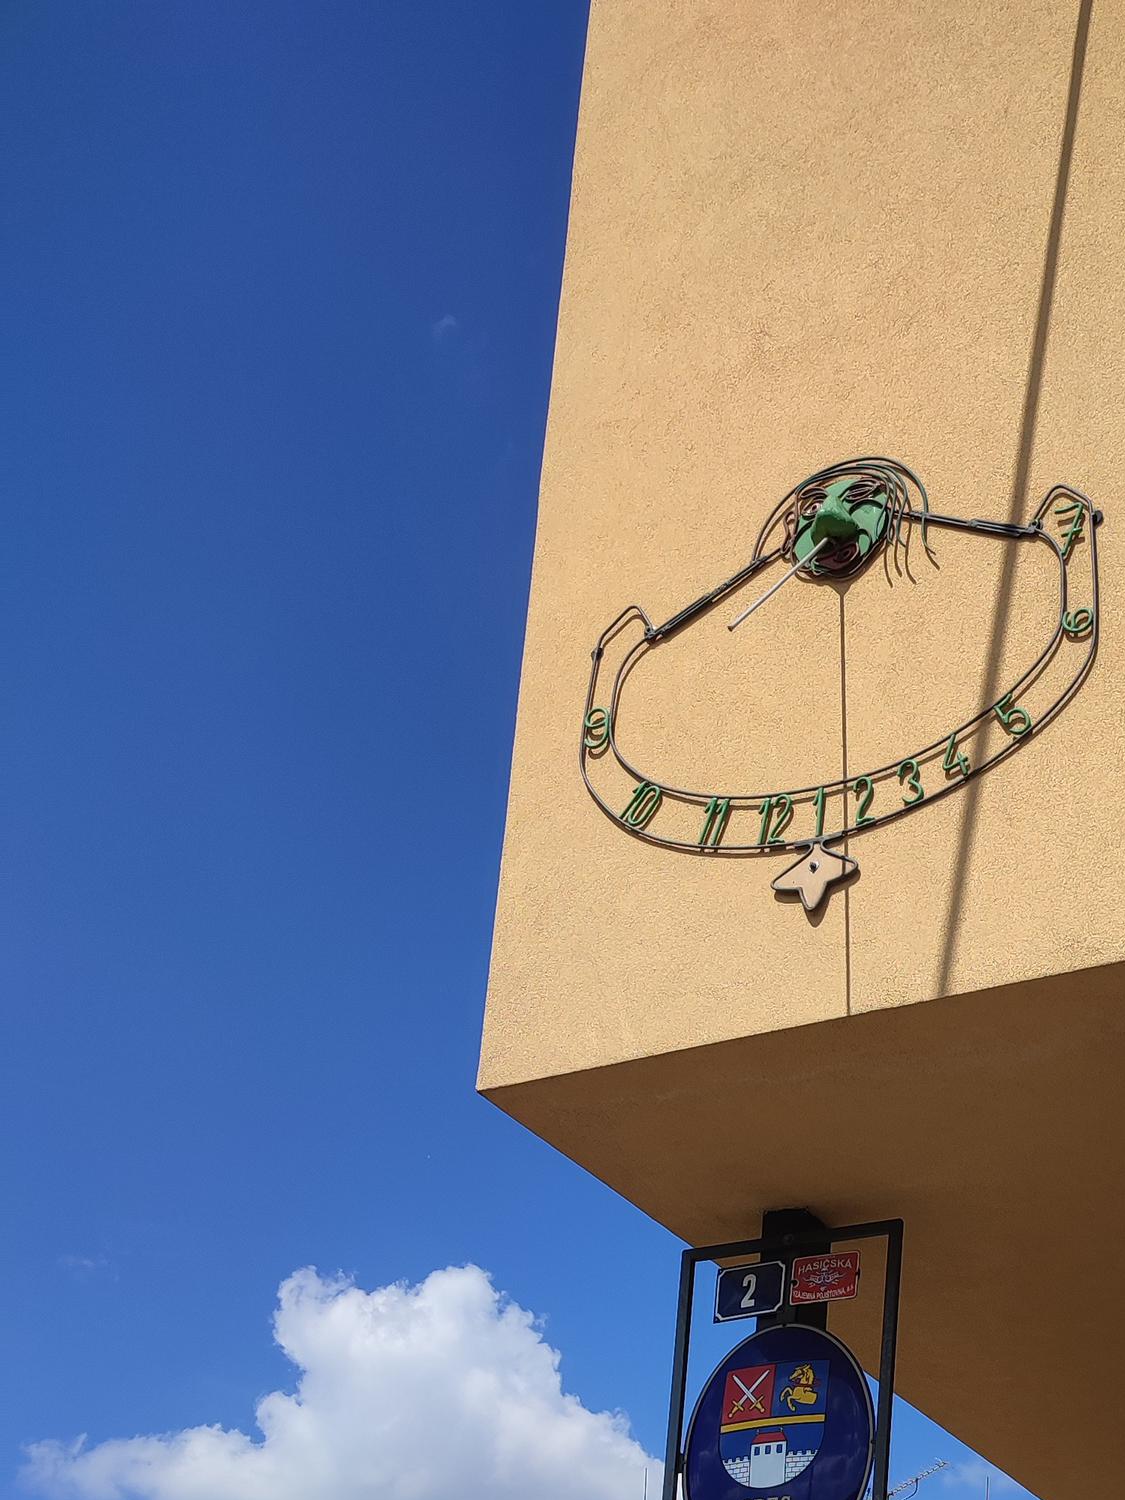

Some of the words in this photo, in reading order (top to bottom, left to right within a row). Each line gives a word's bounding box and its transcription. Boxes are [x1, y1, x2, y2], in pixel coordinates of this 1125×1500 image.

[1054, 502, 1084, 556] 7
[585, 707, 611, 749] 9
[993, 693, 1032, 735] 5
[942, 733, 968, 776] 4
[624, 782, 662, 825] 10
[853, 776, 876, 824] 2
[900, 759, 924, 804] 3
[701, 798, 730, 846] 11
[758, 795, 793, 845] 12
[812, 787, 825, 837] 1
[741, 1274, 756, 1308] 2
